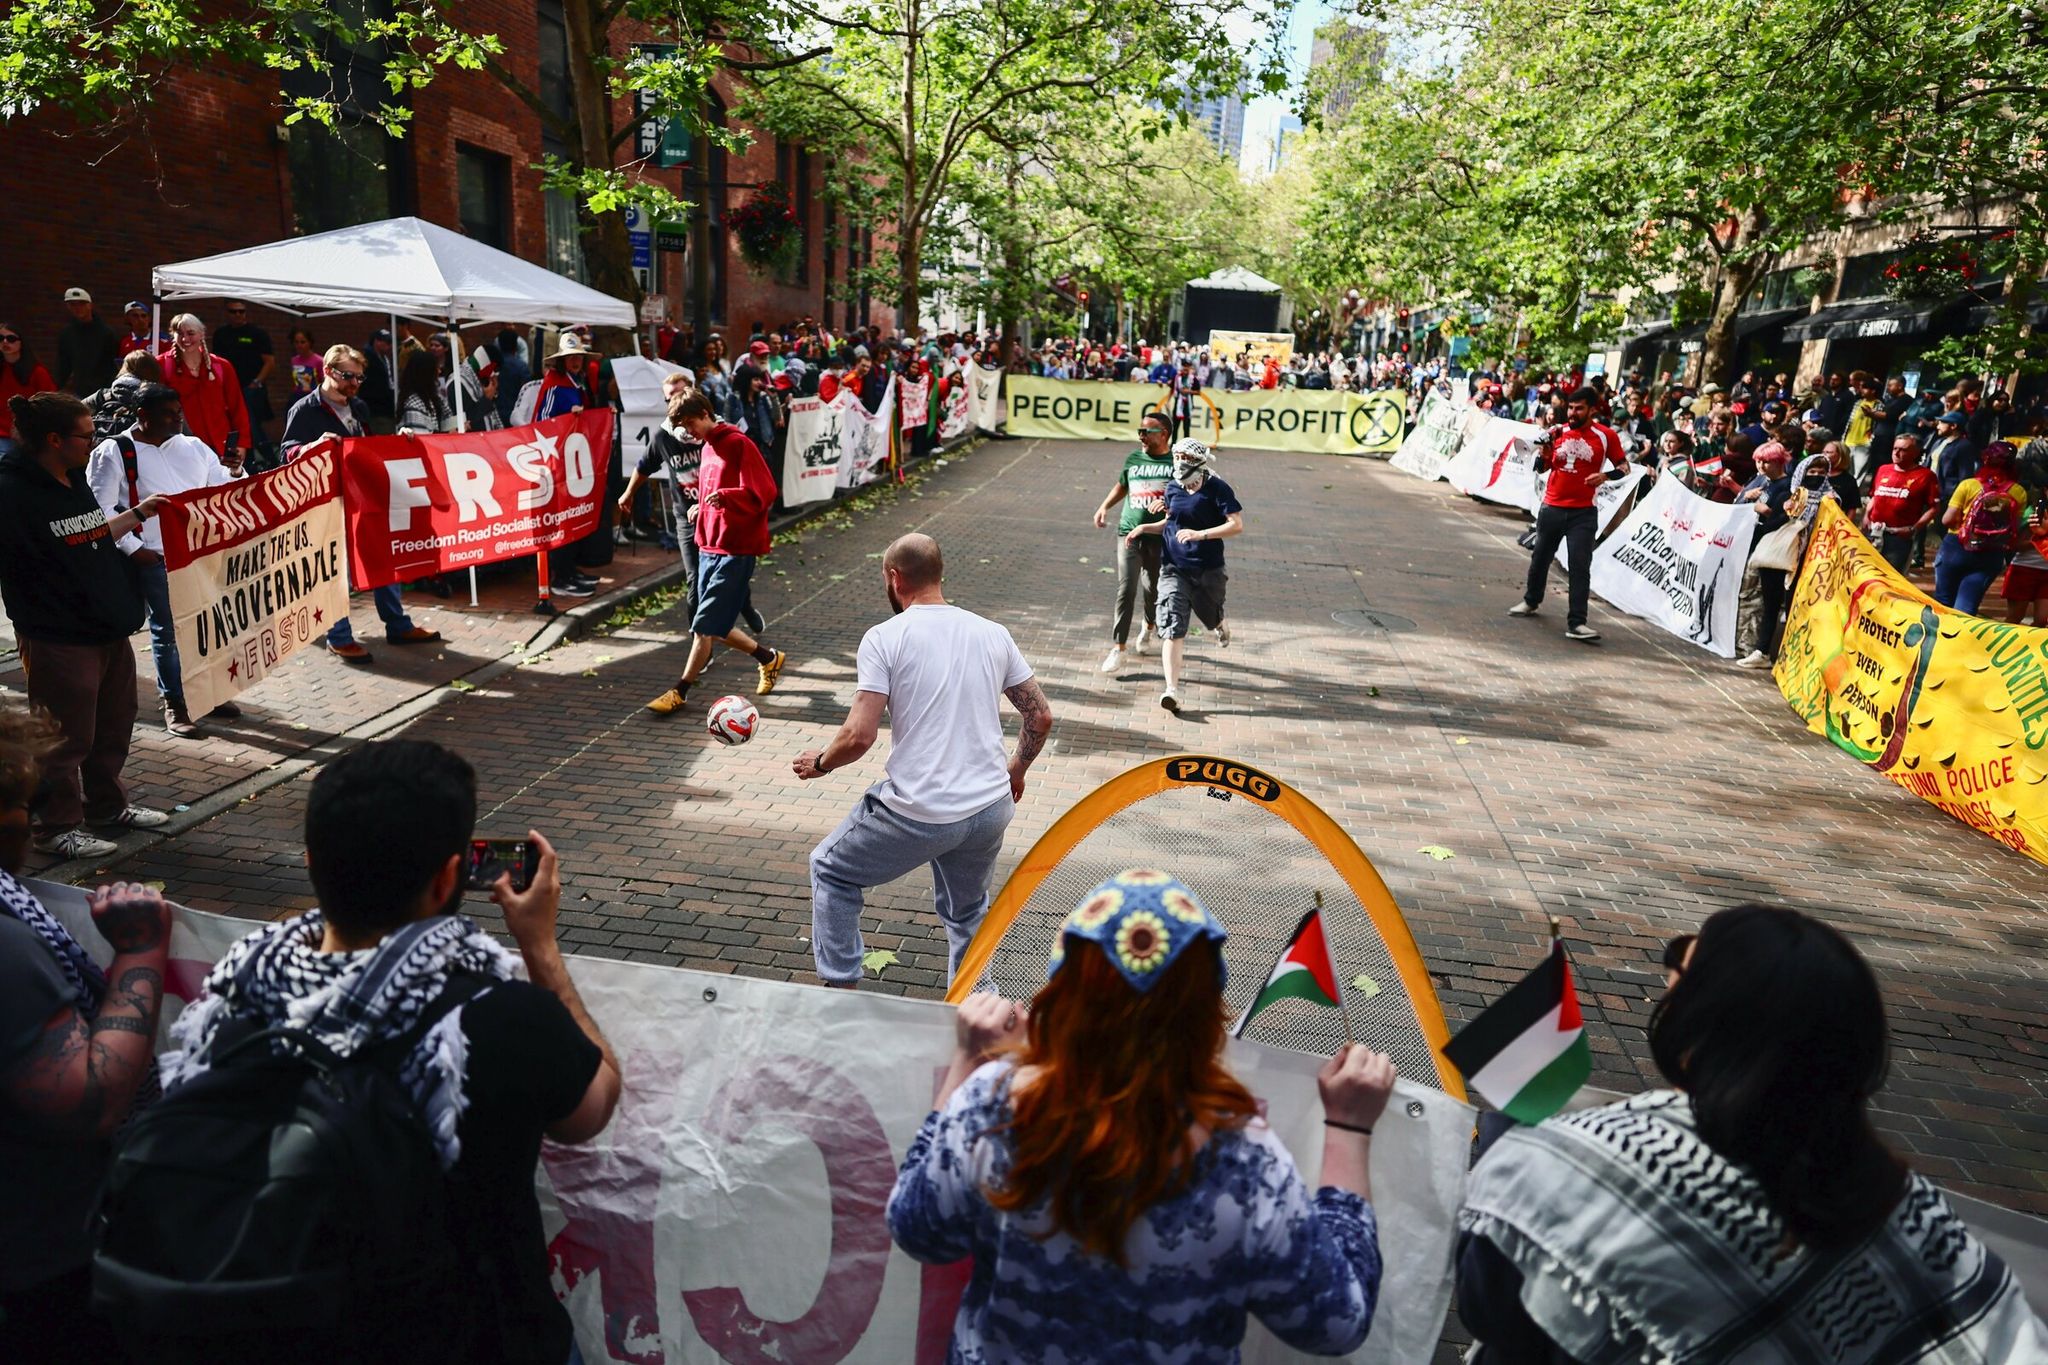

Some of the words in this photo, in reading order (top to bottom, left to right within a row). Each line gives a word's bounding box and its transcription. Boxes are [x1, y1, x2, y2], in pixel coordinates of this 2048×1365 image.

[1013, 394, 1130, 424] PEOPLE
[1235, 408, 1347, 434] PROFIT
[384, 430, 596, 533] FRSO
[1128, 464, 1174, 478] IRANIAN
[184, 482, 268, 552] RESIST
[263, 450, 334, 515] TRUMP
[391, 533, 456, 555] Freedom
[458, 525, 491, 543] Road
[492, 515, 541, 537] Socialist
[543, 501, 594, 526] Organization
[226, 540, 266, 586] MAKE
[270, 532, 290, 564] THE
[449, 548, 484, 562] frso.org
[1612, 544, 1669, 587] LIBERATION
[243, 605, 310, 680] FRSO
[1858, 615, 1901, 648] PROTECT
[1856, 651, 1884, 681] EVERY
[1840, 682, 1879, 722] PERSON
[1177, 761, 1270, 798] PUGG
[1946, 756, 2014, 797] POLICE
